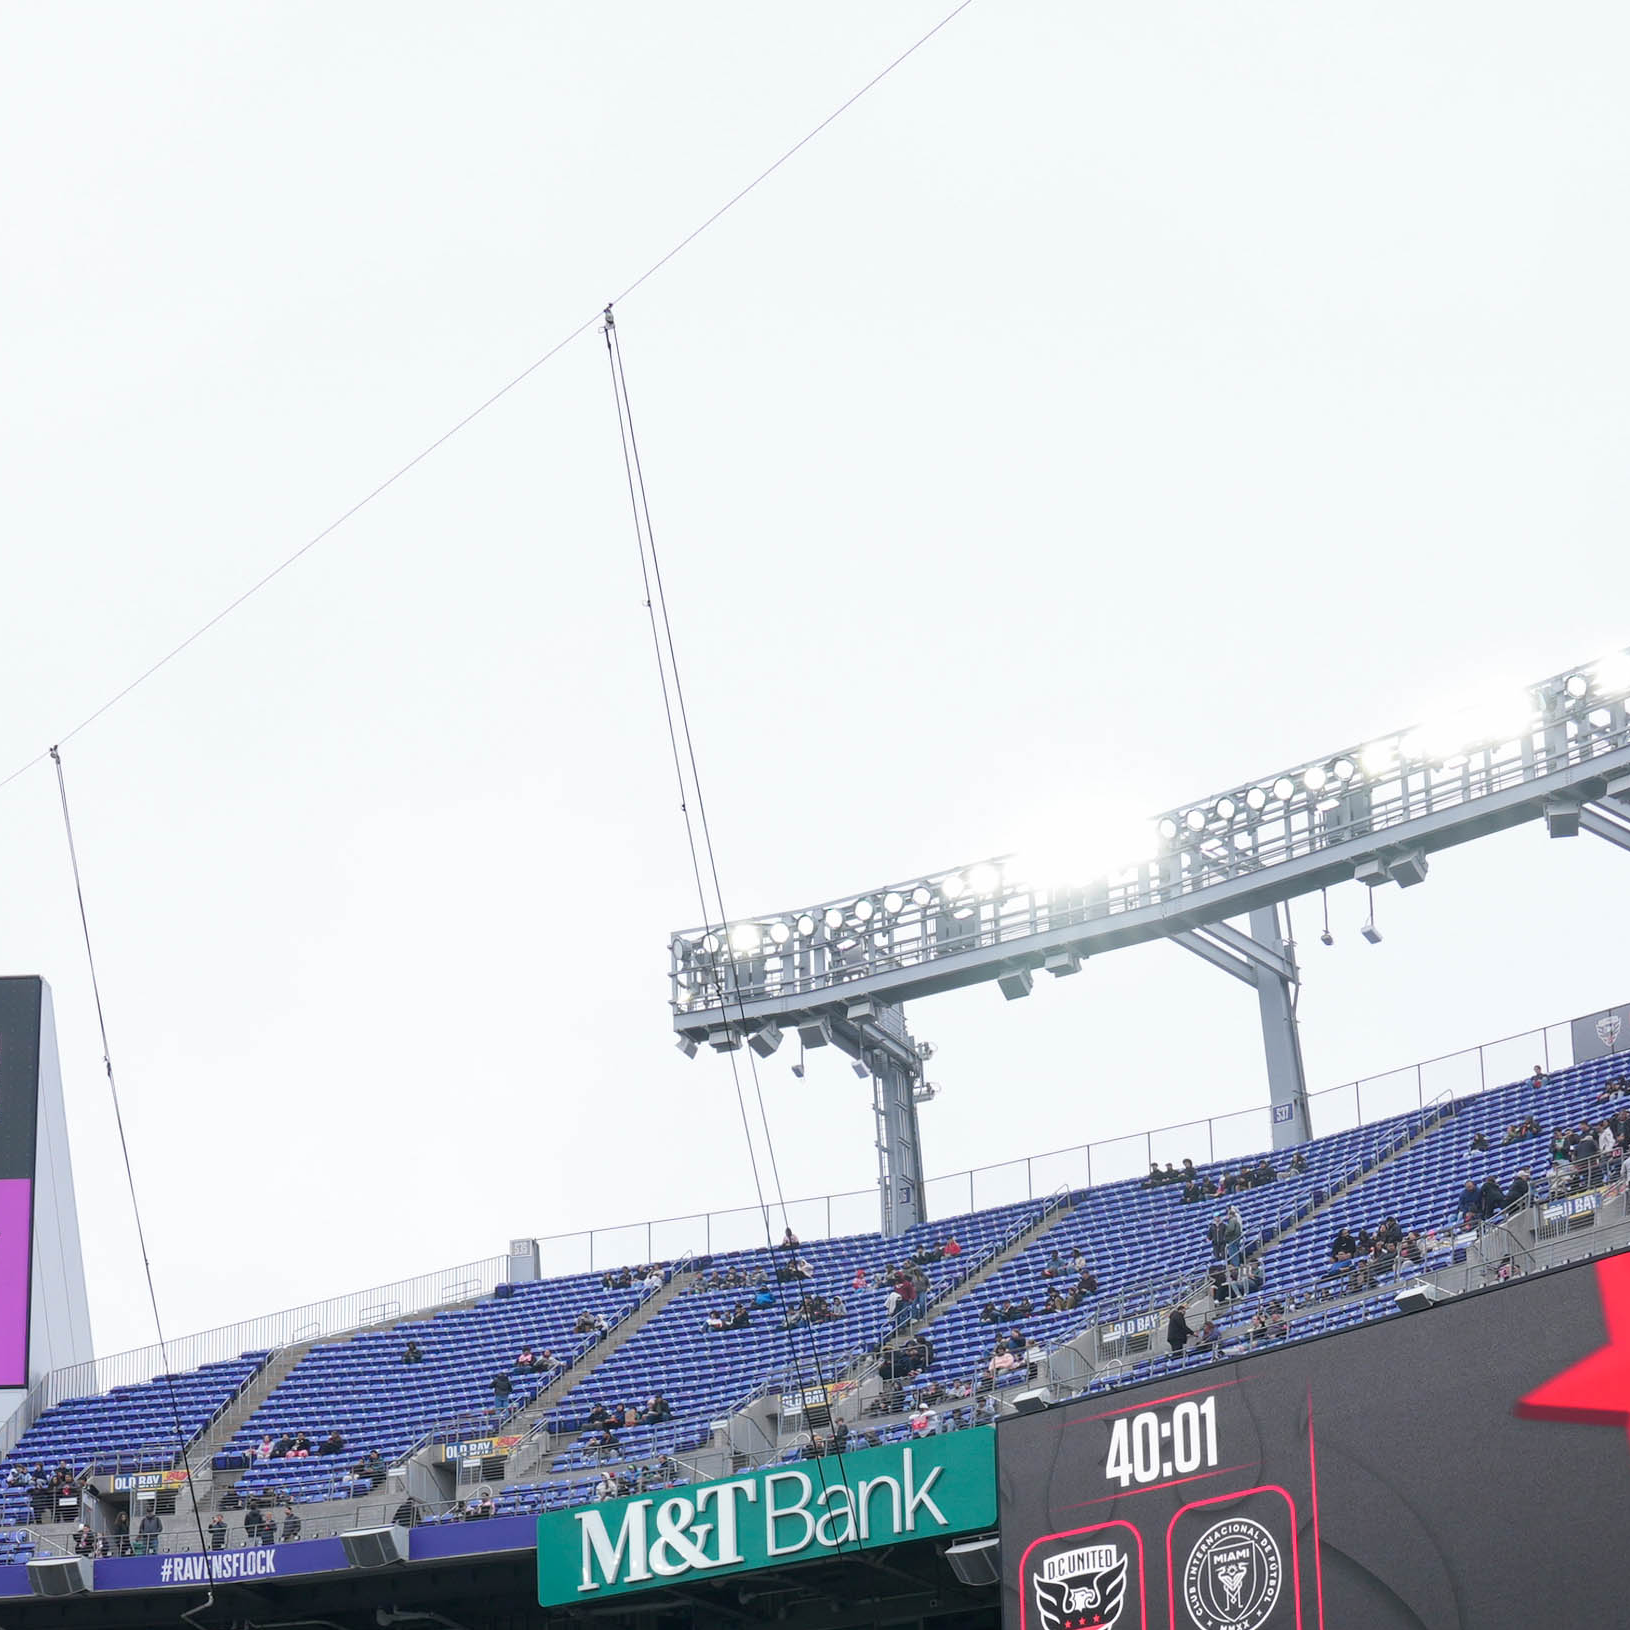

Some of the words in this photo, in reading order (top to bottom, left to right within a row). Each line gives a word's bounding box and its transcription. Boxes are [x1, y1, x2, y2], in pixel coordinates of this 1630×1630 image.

[445, 1443, 465, 1459] OLD
[1106, 1396, 1218, 1487] 40:01
[573, 1478, 758, 1593] M&T
[765, 1447, 949, 1557] Bank
[160, 1549, 275, 1583] #RAVENSFLOCK
[1190, 1523, 1260, 1580] INTERNACIONAL
[1213, 1548, 1250, 1565] MIAMI
[1189, 1587, 1203, 1617] CLUB
